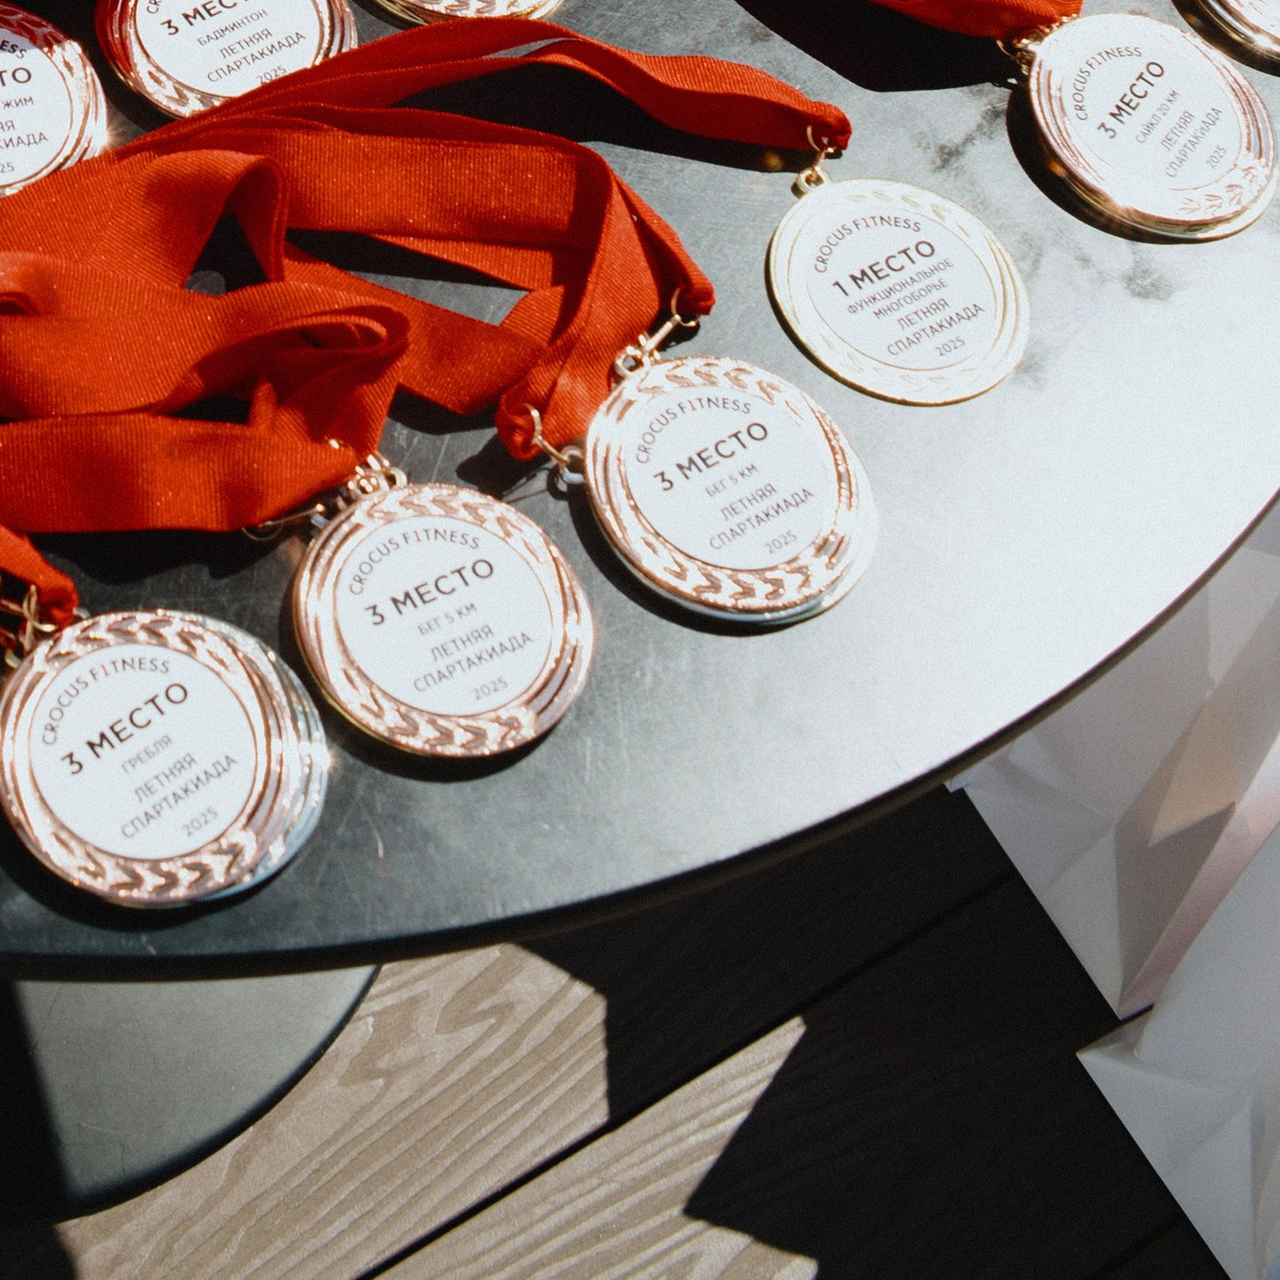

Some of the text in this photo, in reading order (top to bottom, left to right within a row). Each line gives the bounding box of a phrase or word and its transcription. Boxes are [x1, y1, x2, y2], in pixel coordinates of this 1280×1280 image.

[160, 19, 179, 36] 3
[197, 9, 268, 46] БАДМИНТОН
[219, 28, 273, 59] ЛЕТНЯЯ
[207, 31, 307, 83] СПАРТАКИАДА
[2, 97, 34, 110] ЖИМ
[1072, 67, 1091, 121] CROCUS
[1098, 61, 1165, 139] 3 МЕСТО
[1160, 110, 1195, 151] ЛЕТНЯЯ
[814, 224, 852, 273] CROCUS
[832, 240, 935, 297] 1 МЕСТО
[847, 257, 954, 314] ФУНКЦИОНАЛЬНОЕ
[873, 277, 949, 319] МНОГОБОРЬЕ
[887, 303, 986, 357] СПАРТАКИАДА
[897, 298, 950, 331] ЛЕТНЯЯ
[934, 336, 966, 357] 2025
[636, 408, 677, 464] CROCUS
[653, 422, 768, 492] 3 МЕСТО
[705, 463, 759, 498] БЕГ КМ
[720, 483, 778, 521] ЛЕТНЯЯ
[709, 488, 814, 550] СПАРТАКИАДА
[349, 538, 400, 596] CROCUS
[365, 559, 494, 626] 3 МЕСТО
[457, 602, 477, 620] КМ
[414, 633, 534, 692] СПАРТАКИАДА
[431, 624, 495, 662] ЛЕТНЯЯ
[42, 677, 89, 746] CROCUS
[61, 683, 188, 775] 3 МЕСТО
[121, 734, 174, 774] ГРЕБЛЯ
[134, 753, 198, 804] ЛЕТНЯЯ
[121, 755, 238, 839] СПАРТАКИАДА
